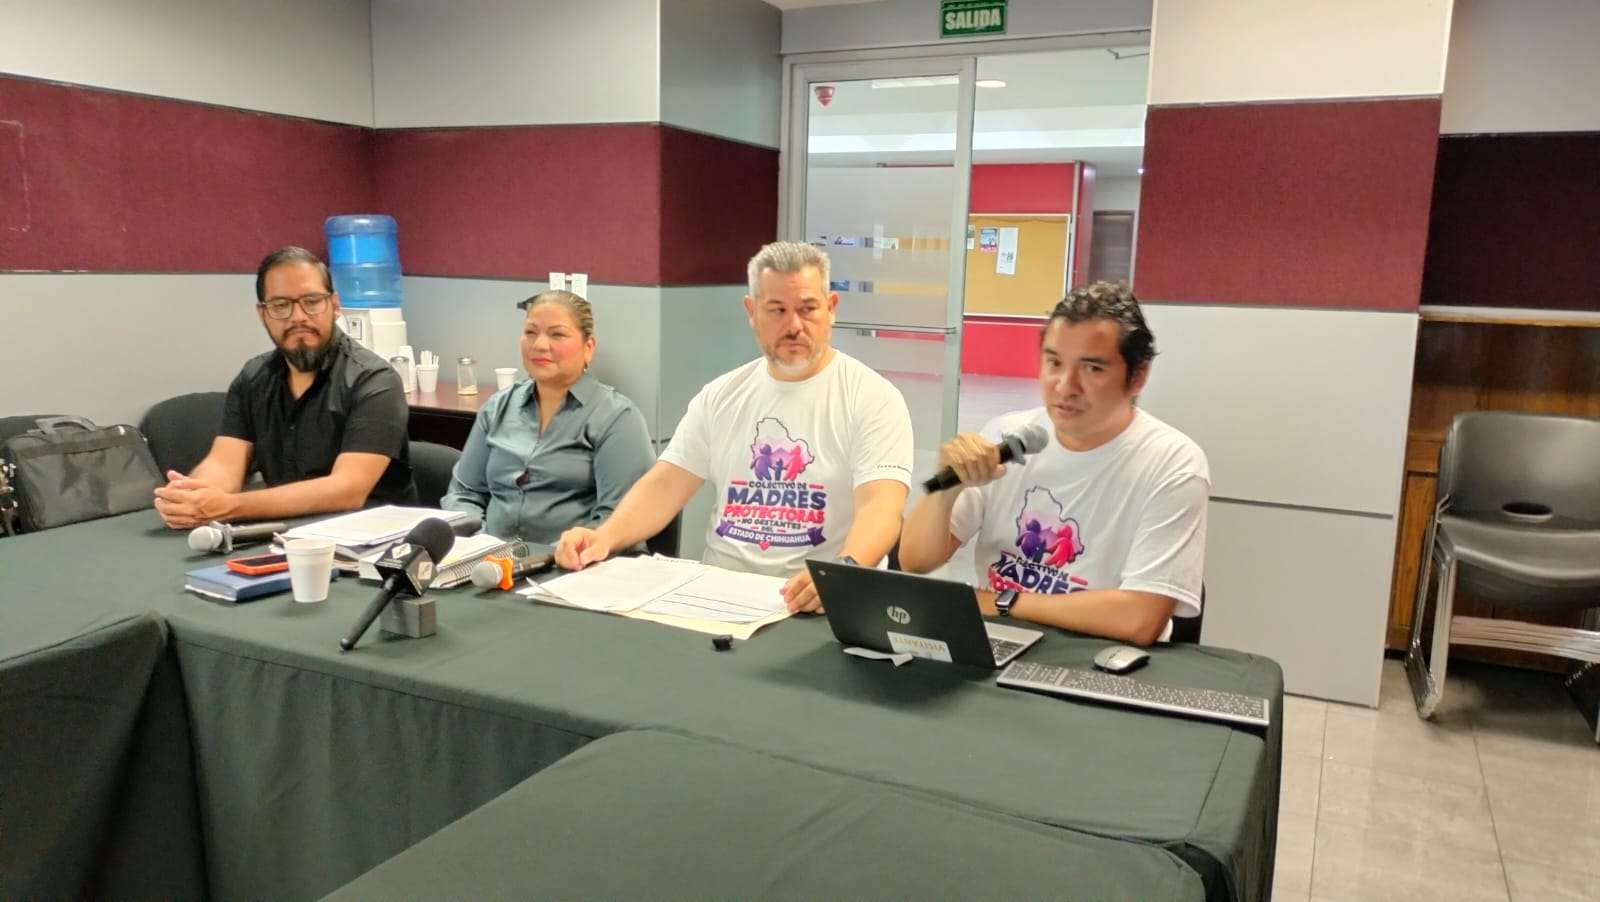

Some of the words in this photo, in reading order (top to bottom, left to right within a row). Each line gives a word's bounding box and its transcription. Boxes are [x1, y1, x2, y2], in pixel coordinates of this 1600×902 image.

[945, 7, 1001, 30] SALIDA
[749, 481, 795, 490] COLECTIVO
[797, 482, 807, 490] DE
[727, 487, 827, 510] MADRES
[723, 505, 825, 524] PROTECTORAS
[754, 519, 801, 529] GESTANTES
[728, 527, 754, 539] ESTADO
[755, 533, 764, 541] DE
[766, 535, 811, 543] CHIHUAHUA
